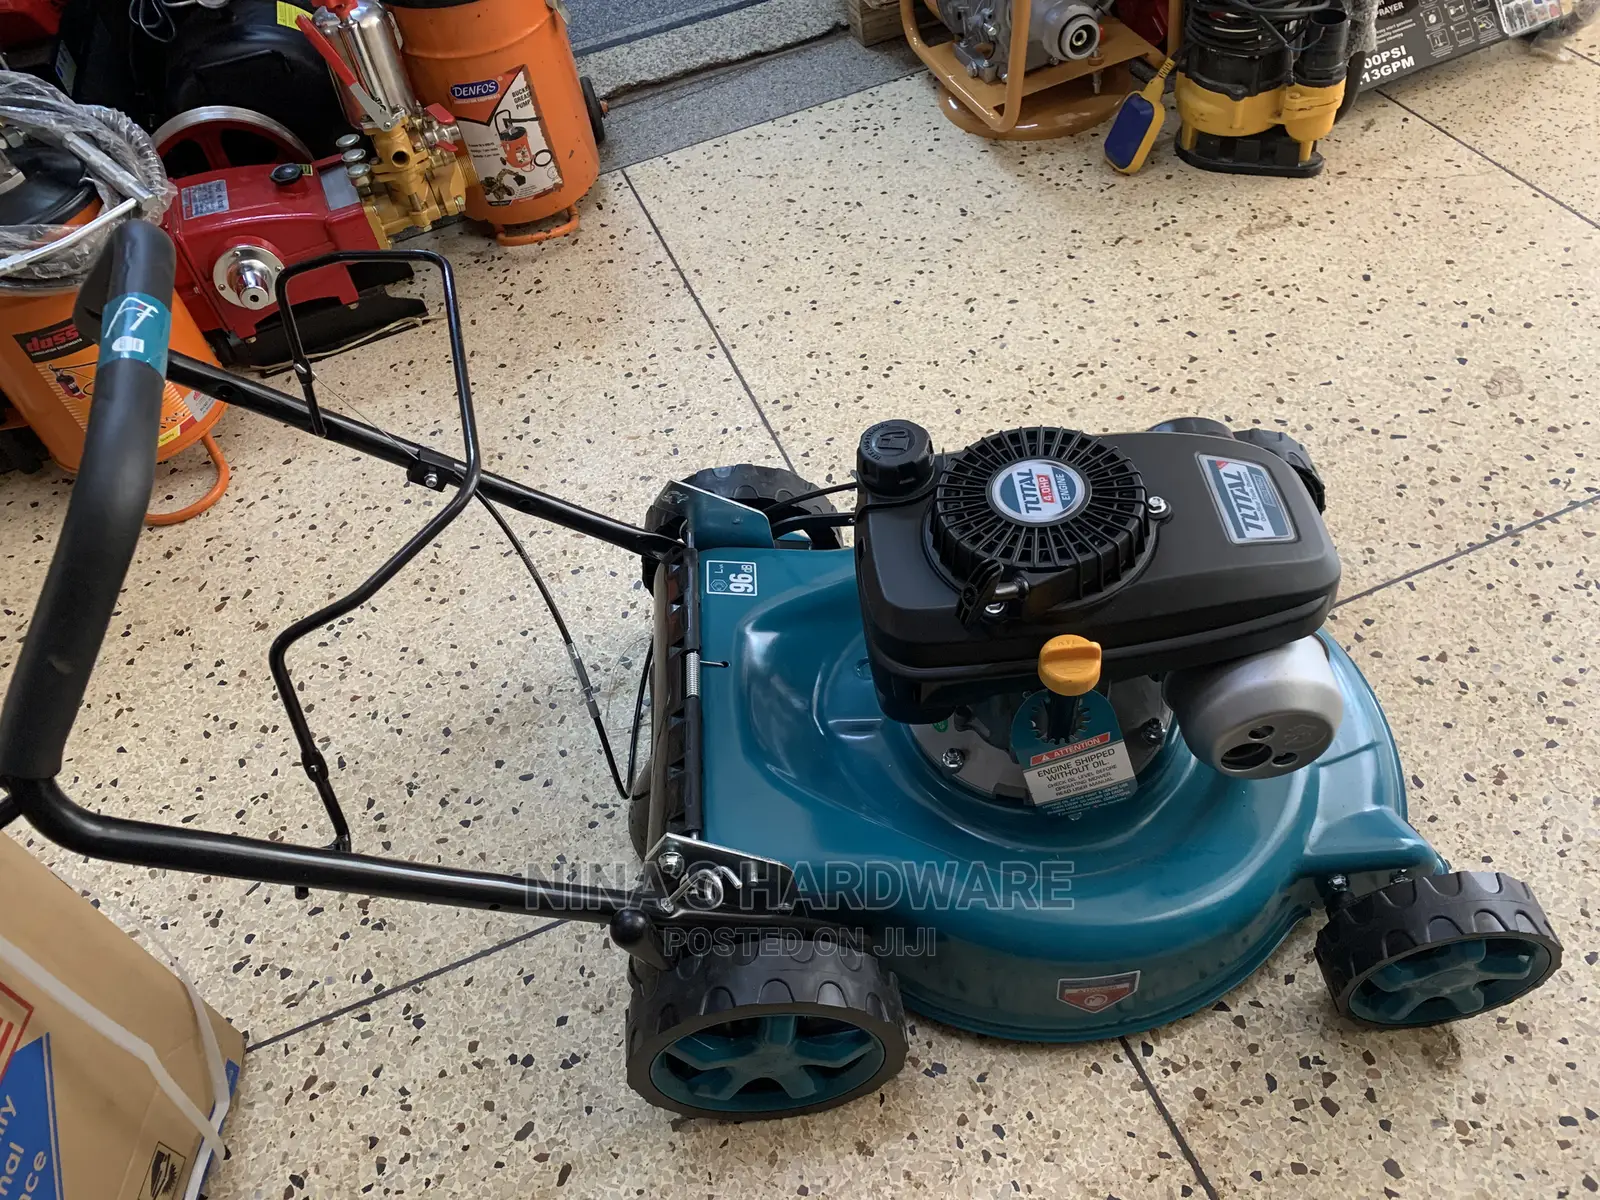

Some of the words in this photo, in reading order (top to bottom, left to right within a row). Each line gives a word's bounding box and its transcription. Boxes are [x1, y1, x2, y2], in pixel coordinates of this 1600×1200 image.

[1376, 2, 1404, 17] RAYER
[452, 81, 496, 98] DENFOS
[515, 99, 531, 110] PUMP
[1016, 468, 1042, 514] TOTAL
[1039, 476, 1054, 502] 4.0HP
[1055, 473, 1071, 501] ENGINE
[1223, 470, 1264, 532] TOTAL
[1053, 738, 1101, 758] ATTENTION
[1037, 761, 1072, 778] ENGINE
[1074, 748, 1116, 767] SHIPPED
[1046, 764, 1090, 782] WITHOUT
[1047, 779, 1067, 789] CHECK
[1077, 772, 1095, 781] LEVEL
[1055, 779, 1087, 792] OPERATING
